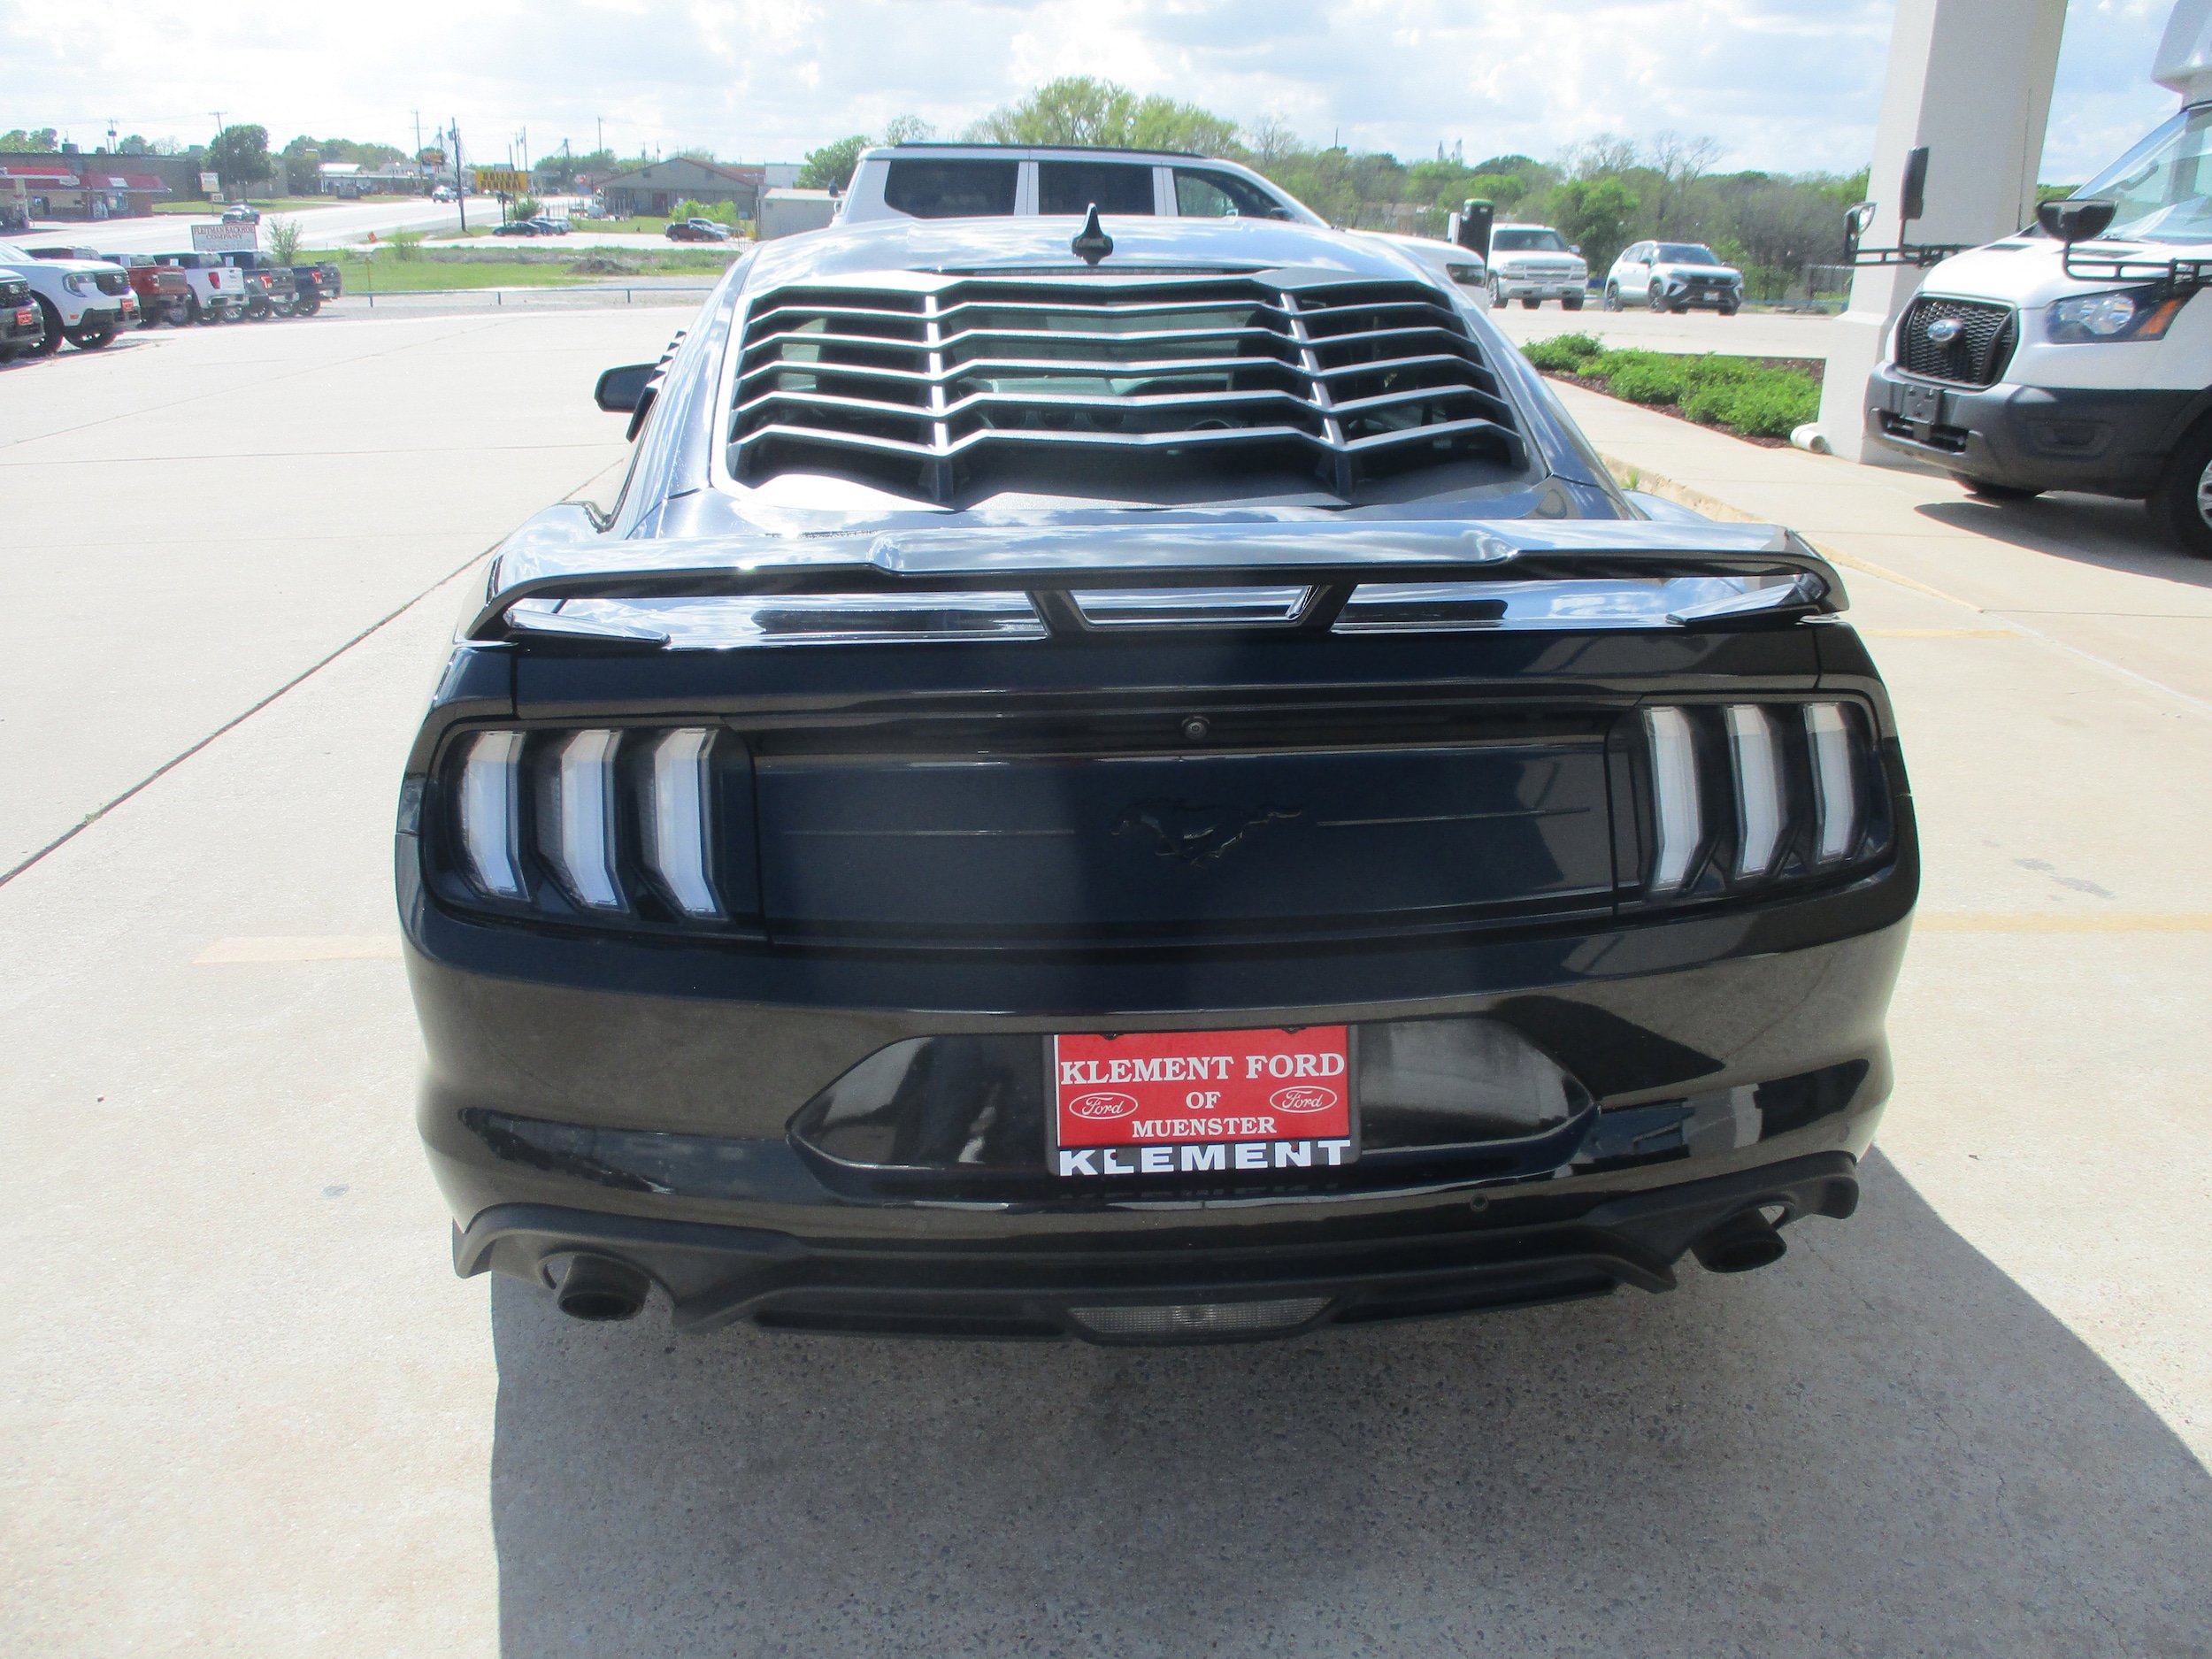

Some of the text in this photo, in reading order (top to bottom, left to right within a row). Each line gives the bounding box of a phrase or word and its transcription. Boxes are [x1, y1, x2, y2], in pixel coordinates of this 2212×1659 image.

[1061, 1053, 1345, 1085] KLEMENT FORD
[1081, 1096, 1124, 1116] Ford
[1186, 1091, 1221, 1110] OF
[1280, 1089, 1324, 1110] Ford
[1132, 1117, 1277, 1138] MUENSTER
[1059, 1140, 1351, 1177] KLEMENT
